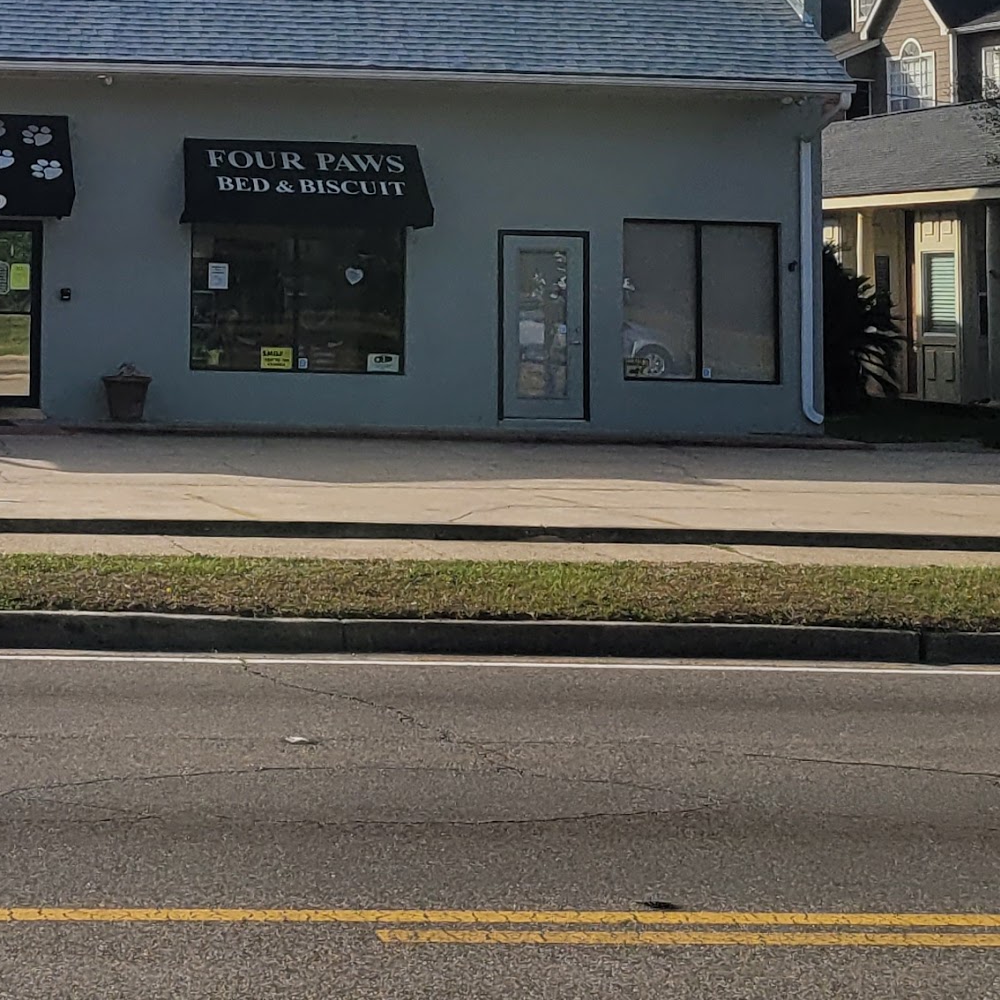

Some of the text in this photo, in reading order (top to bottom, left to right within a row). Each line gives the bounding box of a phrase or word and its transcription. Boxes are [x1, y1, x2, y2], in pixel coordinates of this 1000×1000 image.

[207, 149, 406, 174] FOUR PAWS
[217, 176, 406, 197] BED & BISCUIT
